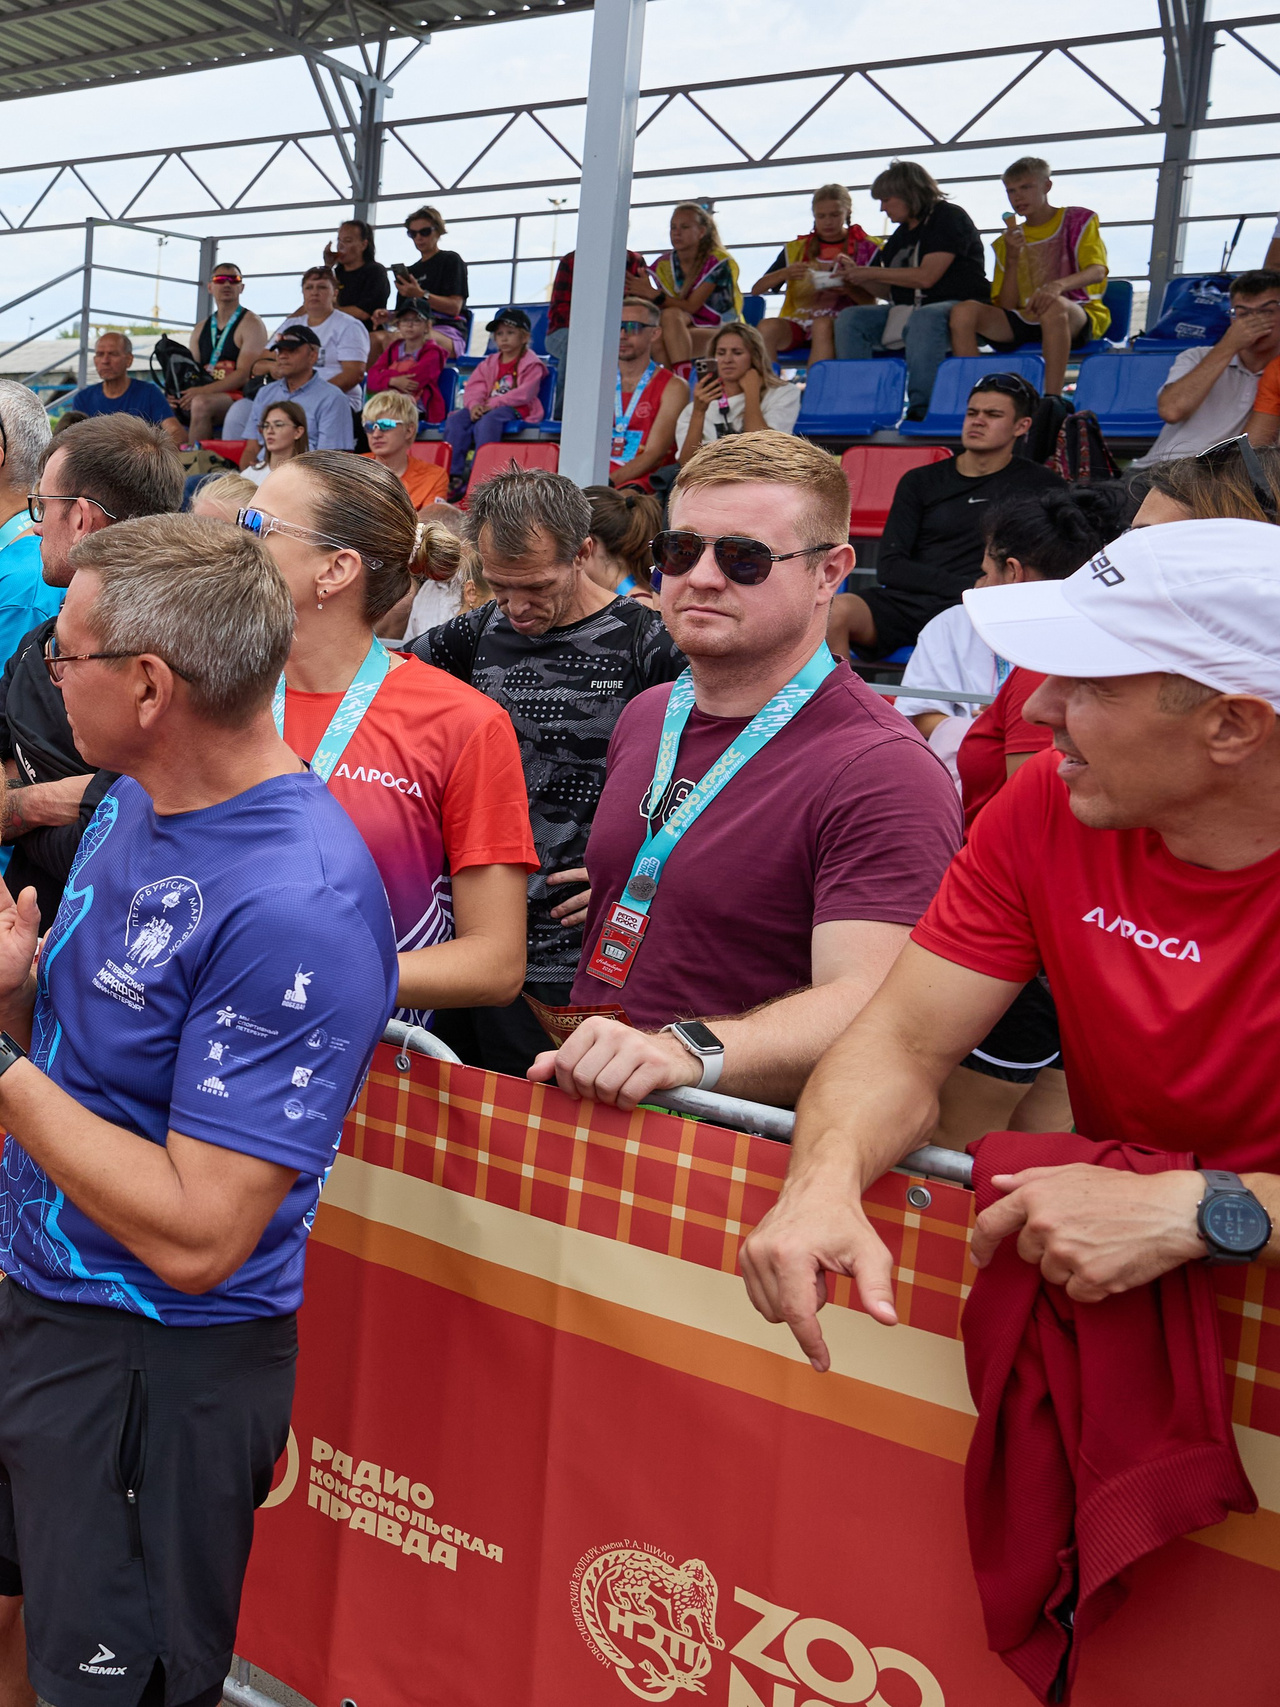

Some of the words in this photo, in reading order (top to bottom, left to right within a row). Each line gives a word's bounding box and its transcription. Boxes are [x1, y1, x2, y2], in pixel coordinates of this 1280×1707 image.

[590, 680, 624, 689] FUTURE
[656, 732, 674, 782] КРОСС
[664, 794, 701, 836] РЕТРО
[698, 747, 742, 794] КРОСС
[615, 917, 639, 930] КРОСС
[96, 967, 146, 1006] МАРАФОН
[311, 1436, 435, 1510] РАДИО
[307, 1482, 458, 1572] ПРАВДА
[309, 1465, 504, 1564] КОМСОМОЛЬСКАЯ
[572, 1545, 602, 1582] ЗООПАРК
[643, 1542, 677, 1565] ШИЛО
[569, 1580, 612, 1669] НОВОСИБИРСКИЙ
[728, 1585, 946, 1707] ZOO
[78, 1662, 128, 1676] DEMIX
